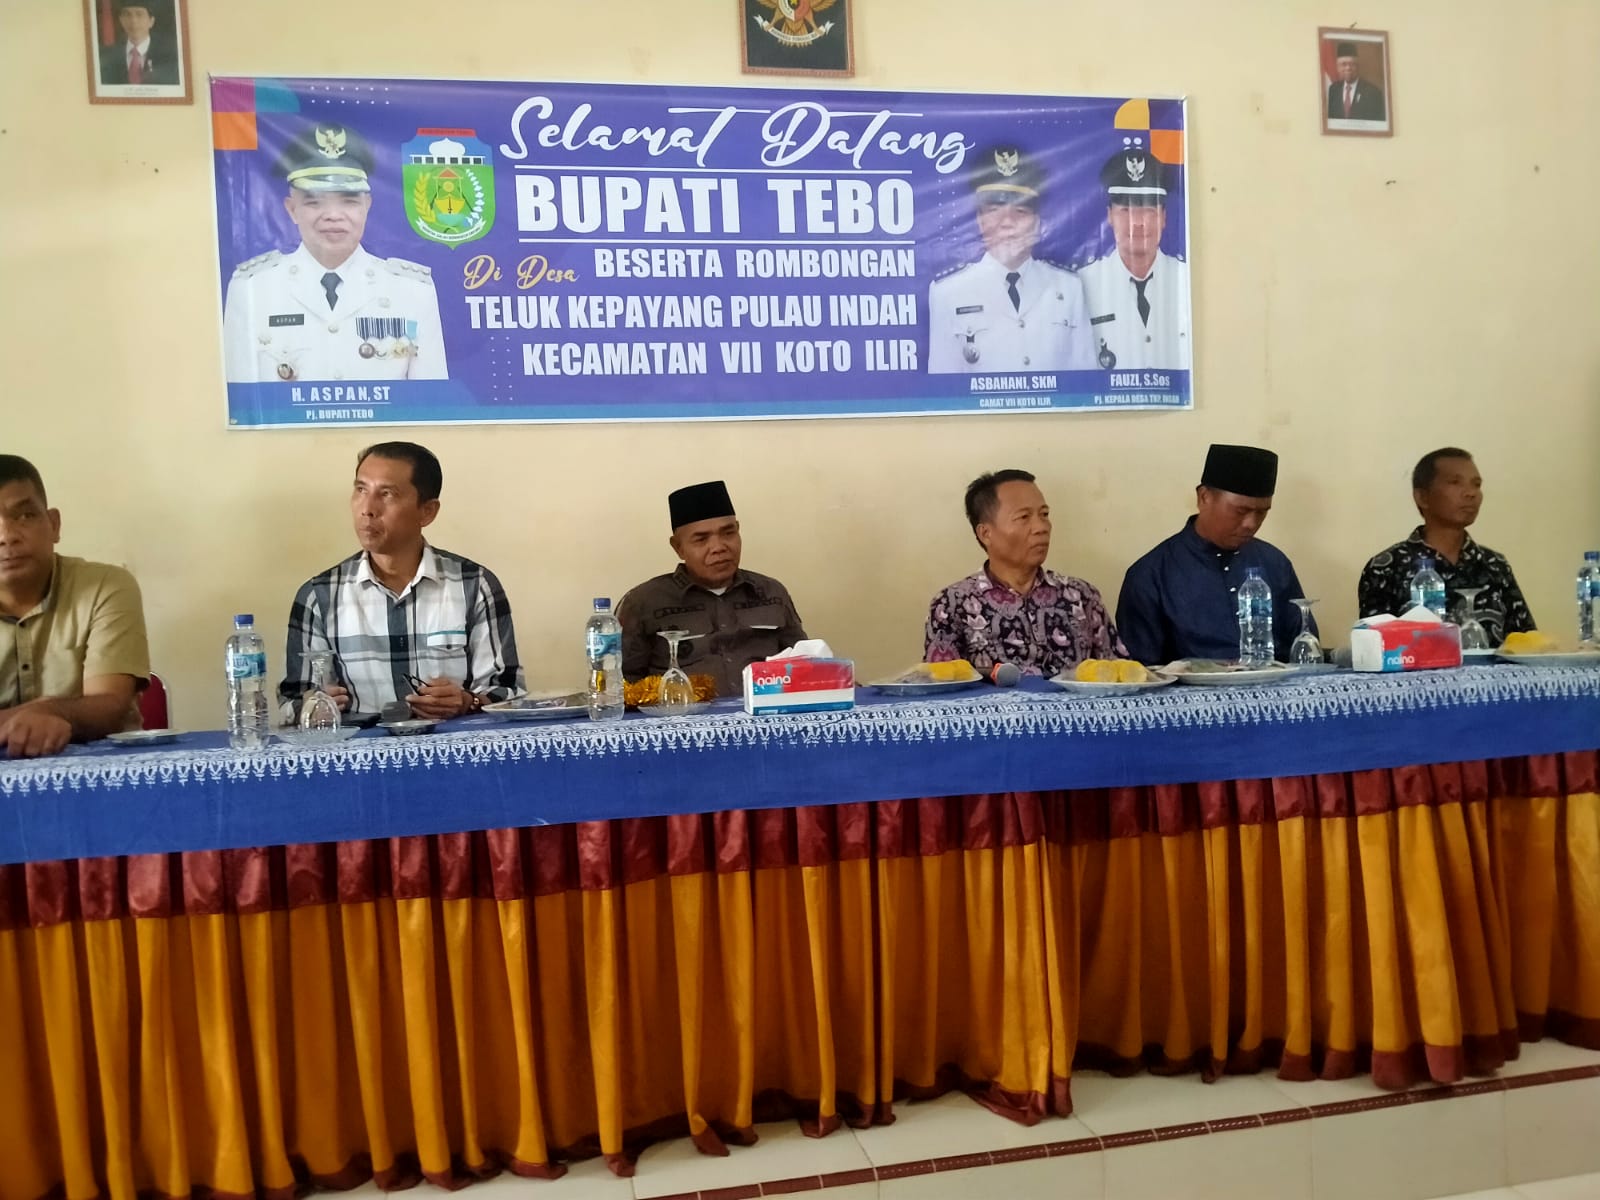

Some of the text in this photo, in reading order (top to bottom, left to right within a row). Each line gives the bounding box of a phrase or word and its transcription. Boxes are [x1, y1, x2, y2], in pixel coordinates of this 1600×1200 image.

[500, 96, 975, 173] Selamat Datang
[515, 175, 915, 235] BUPATI TEBO
[463, 255, 579, 290] Di Desa
[595, 248, 915, 278] BESERTA ROMBONGAN
[465, 294, 917, 329] TELUK KEPAYANG PULAU INDAH
[523, 339, 918, 376] KECAMATAN VII KOTO ILIR
[291, 387, 306, 402] H.
[970, 375, 1057, 391] ASBAHANI, SKM
[1110, 373, 1142, 388] FAUZI,
[757, 673, 792, 687] naina
